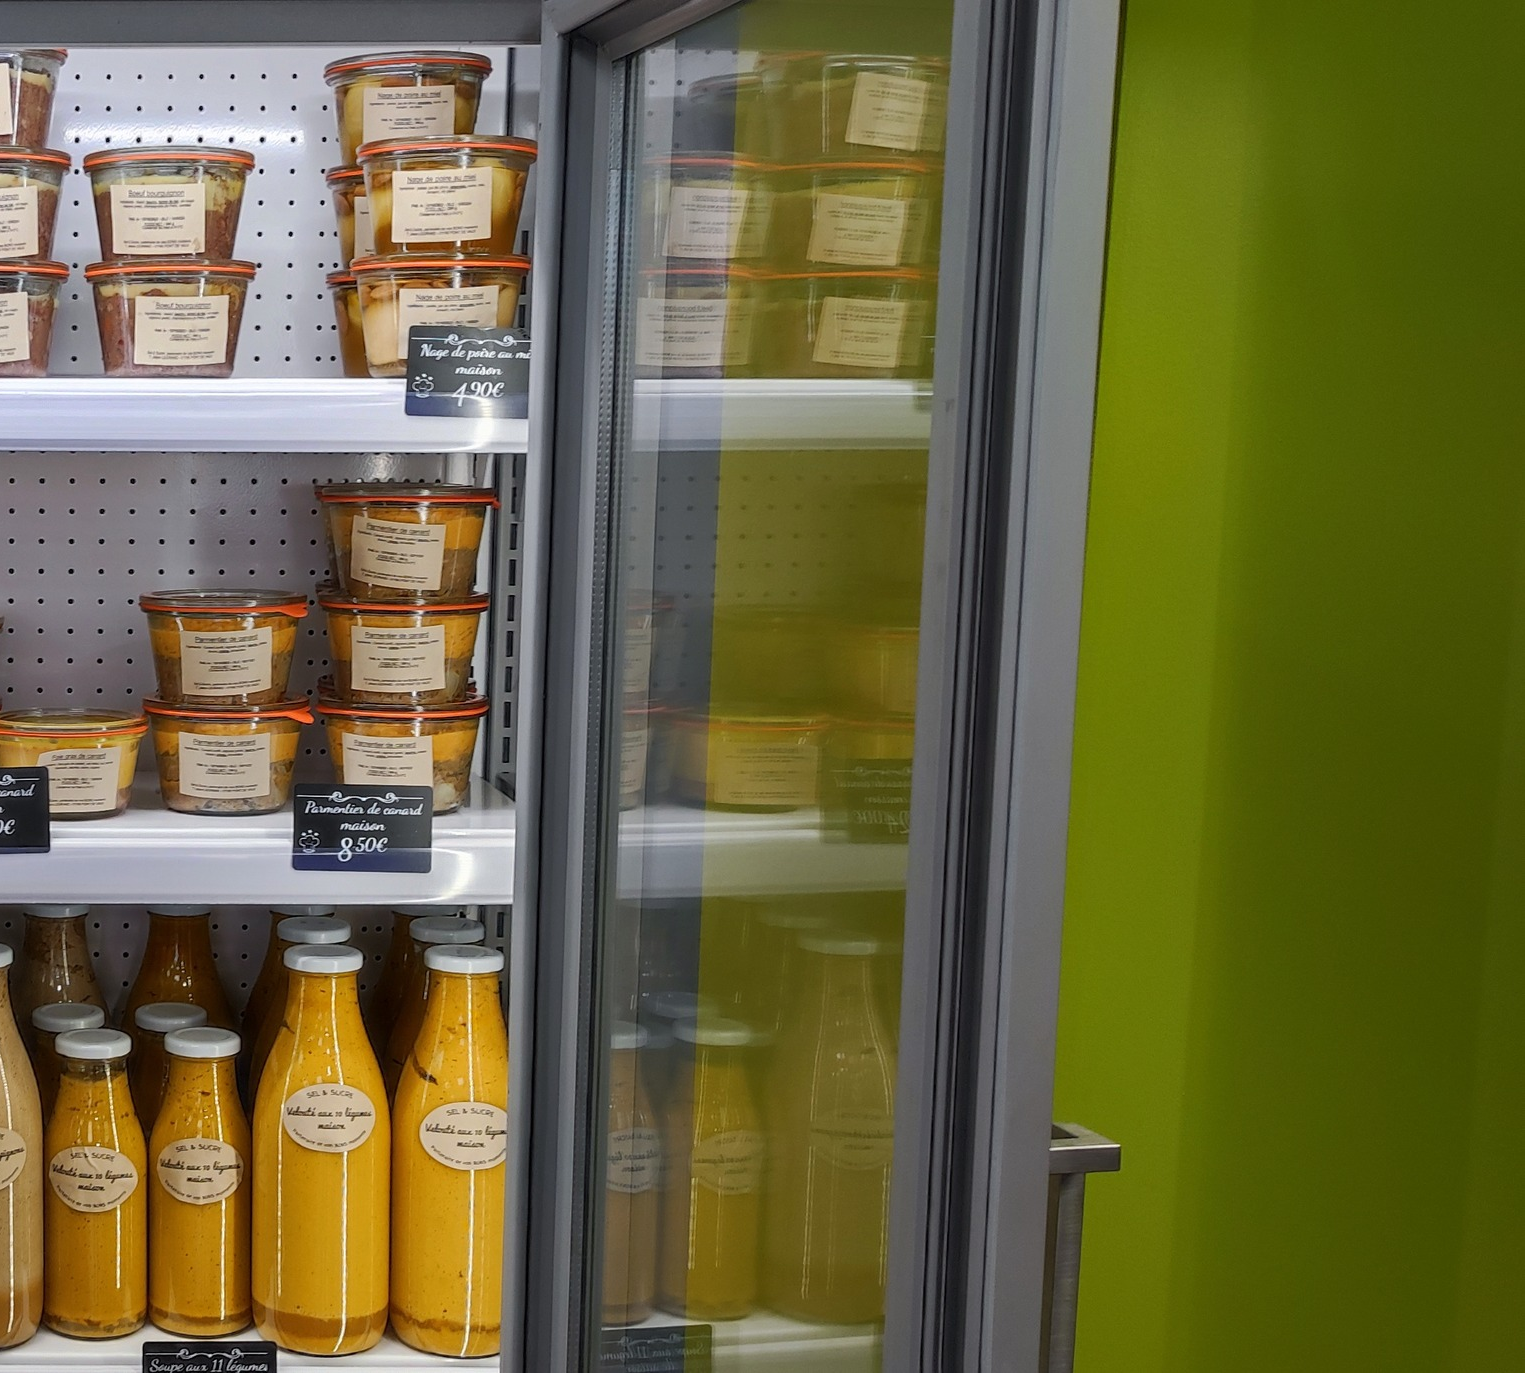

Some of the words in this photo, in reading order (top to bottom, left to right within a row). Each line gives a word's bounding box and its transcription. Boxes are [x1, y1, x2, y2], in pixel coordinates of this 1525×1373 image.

[420, 343, 449, 360] Nage
[450, 345, 466, 358] de
[466, 348, 496, 361] poire
[497, 351, 513, 359] au
[455, 363, 503, 376] maison
[304, 800, 365, 814] Parmentier
[366, 802, 382, 815] de
[383, 803, 423, 816] canard
[340, 820, 386, 831] maison
[149, 1358, 184, 1373] Soupe
[186, 1364, 208, 1372] aux
[211, 1359, 224, 1372] 11
[227, 1358, 268, 1373] légumes
